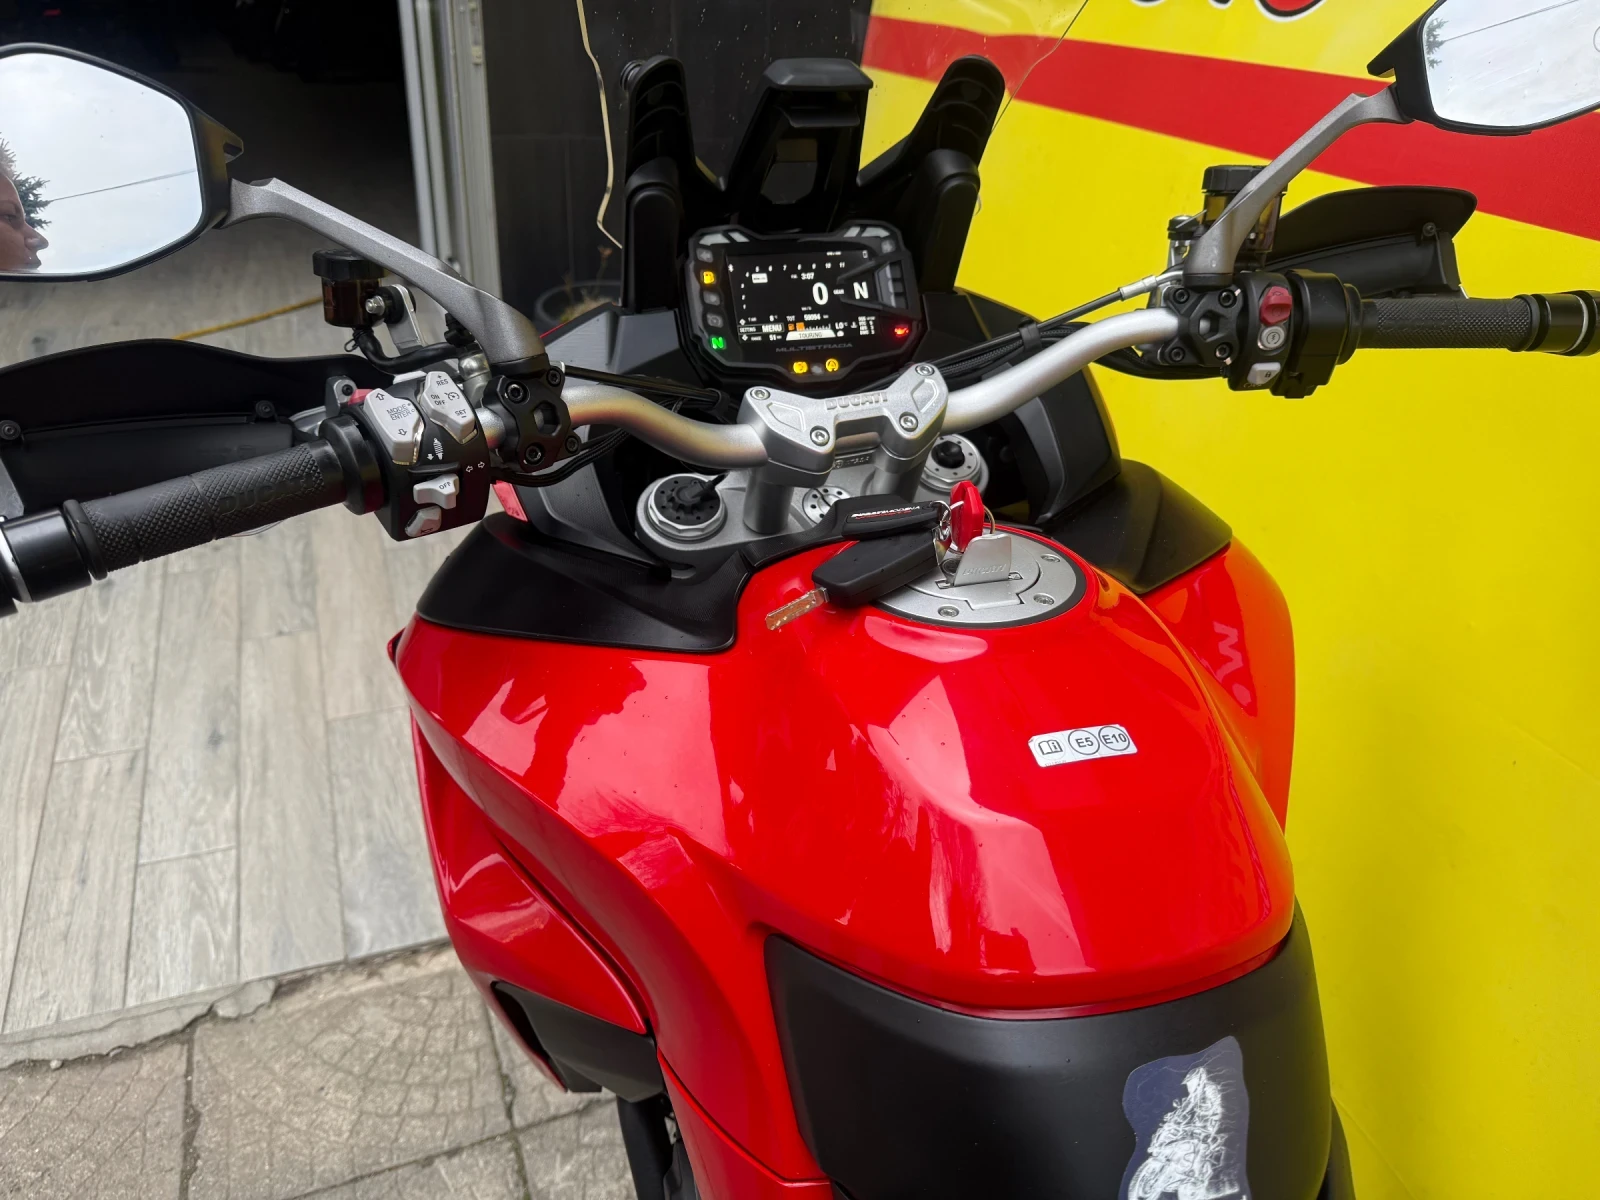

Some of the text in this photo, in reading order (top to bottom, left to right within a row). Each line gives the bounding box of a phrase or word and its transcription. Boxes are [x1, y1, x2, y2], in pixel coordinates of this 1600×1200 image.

[801, 272, 815, 280] 3:07
[812, 282, 829, 306] 0
[853, 281, 869, 299] N
[762, 324, 782, 333] MENU
[775, 343, 853, 353] MULTISTRADA
[436, 378, 449, 387] RES
[825, 392, 888, 410] DUCATI
[386, 403, 408, 415] MODE
[390, 409, 411, 421] ENTER
[1075, 733, 1127, 748] E5 E10
